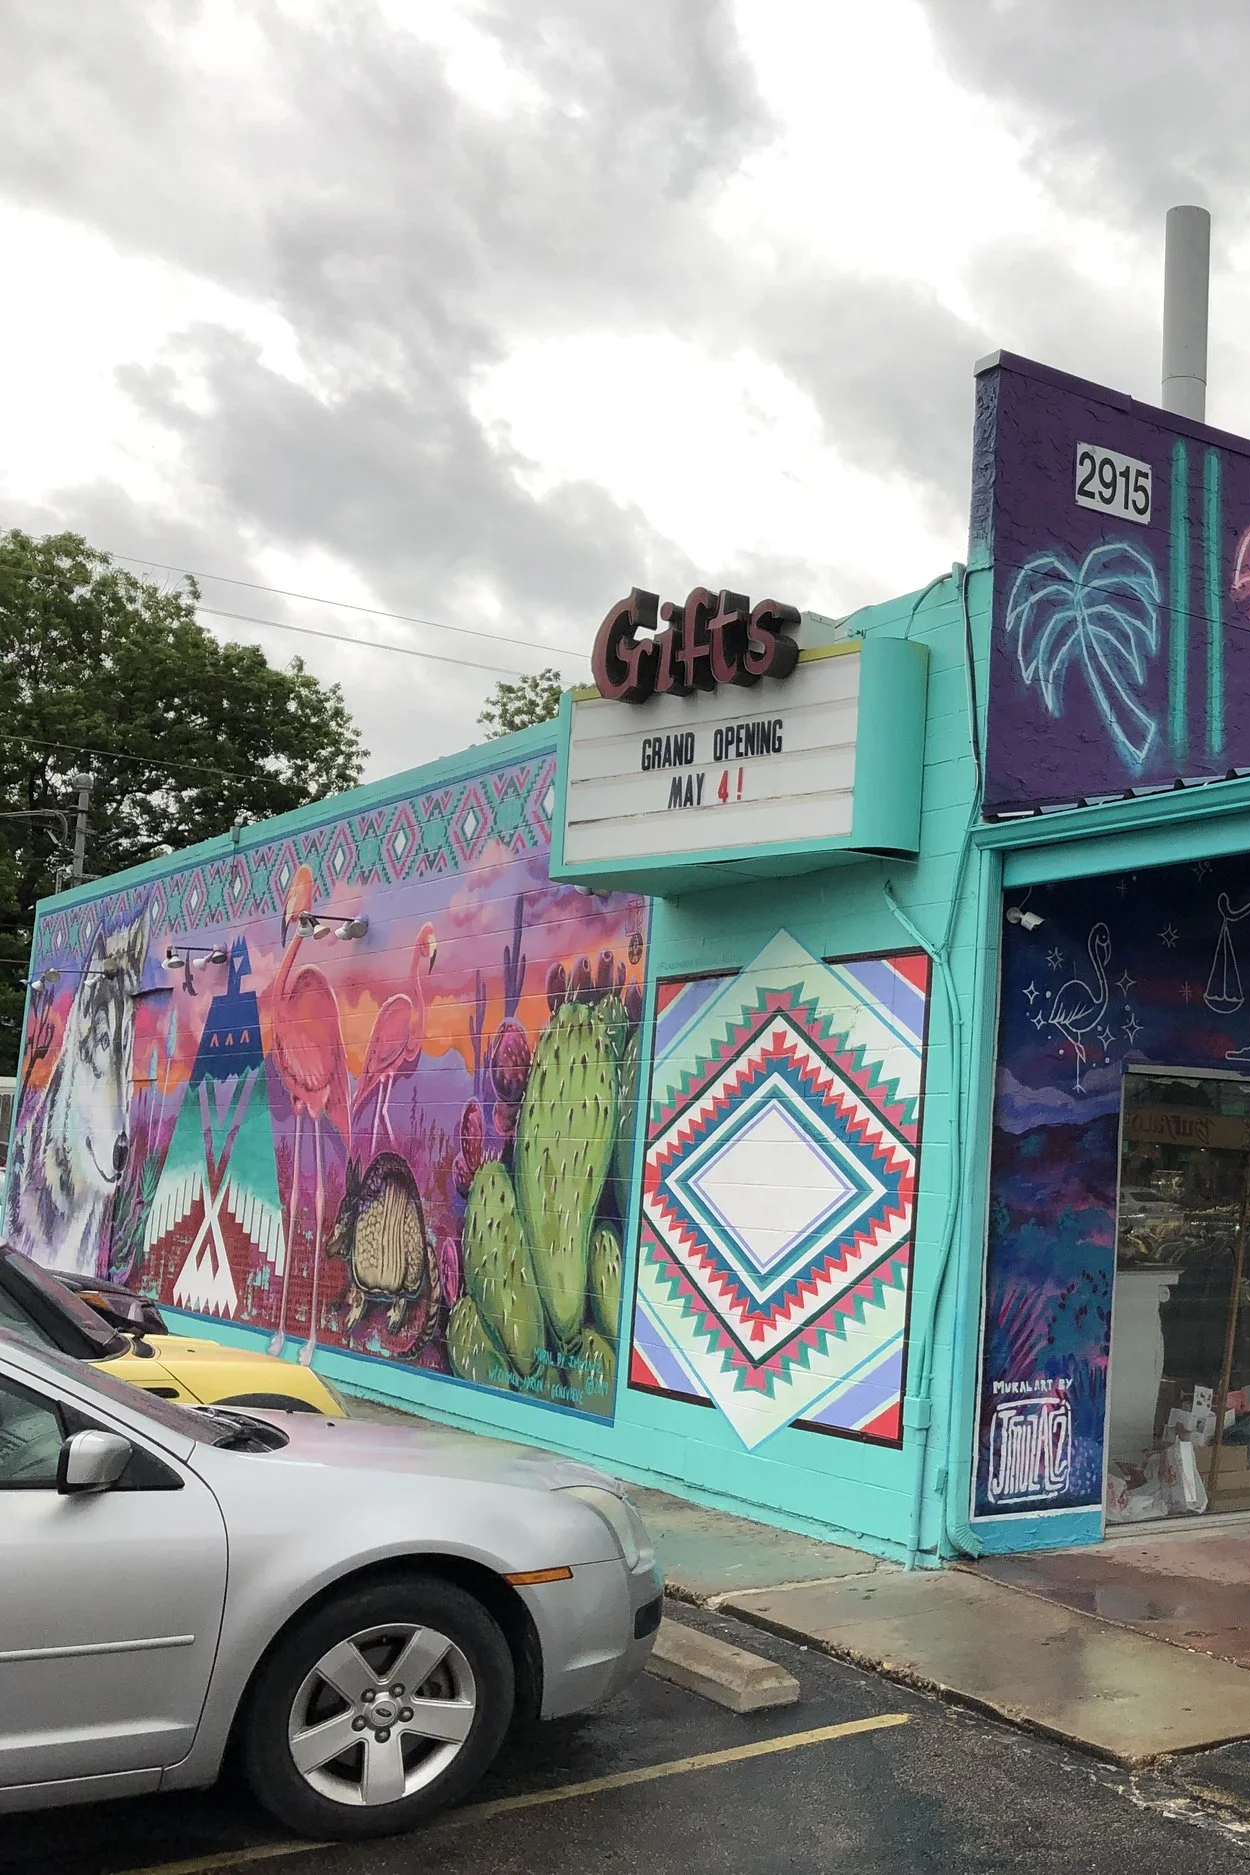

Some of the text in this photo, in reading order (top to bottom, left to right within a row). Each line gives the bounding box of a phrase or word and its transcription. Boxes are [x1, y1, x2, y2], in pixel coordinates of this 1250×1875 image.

[1076, 450, 1150, 516] 2915
[591, 586, 800, 704] Gifts
[641, 719, 783, 771] GRAND OPENING
[667, 772, 705, 809] MAY
[992, 1378, 1074, 1394] MURAL ART BY
